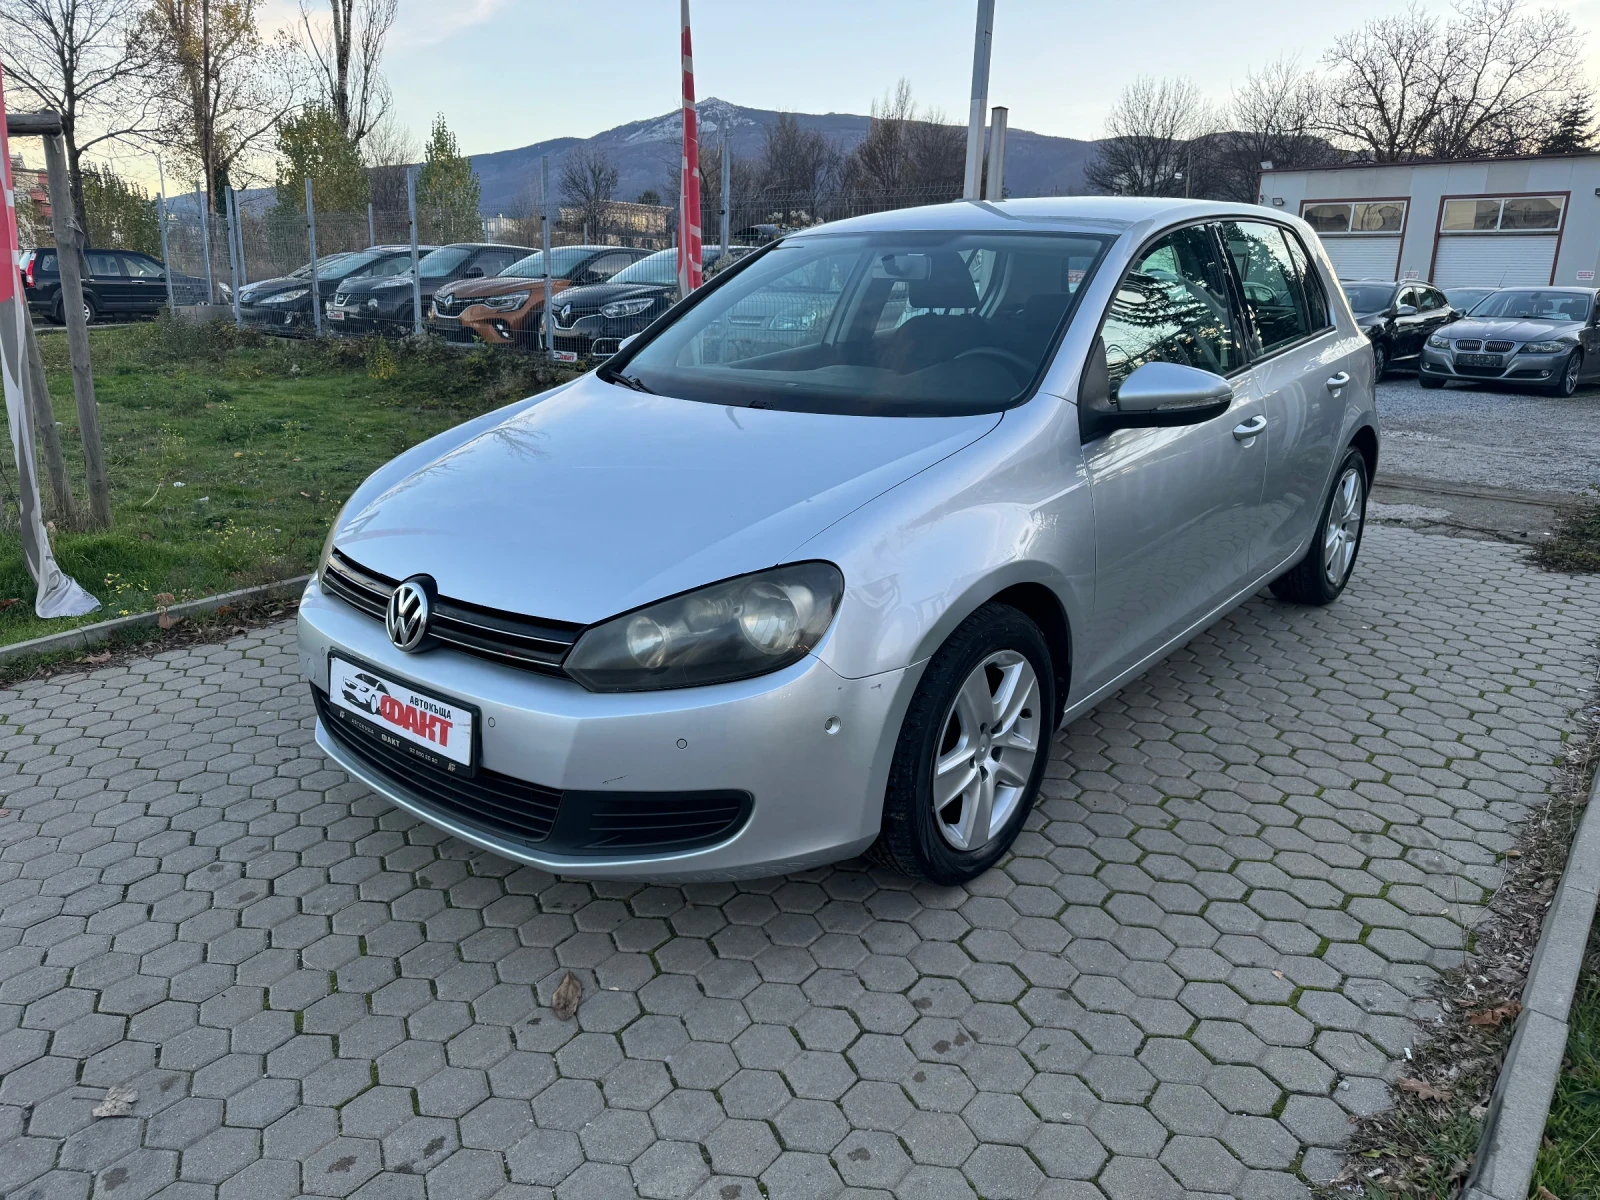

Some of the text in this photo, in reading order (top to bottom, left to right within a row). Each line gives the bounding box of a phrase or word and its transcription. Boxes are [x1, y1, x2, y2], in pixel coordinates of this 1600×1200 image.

[387, 583, 427, 651] VW
[380, 694, 453, 747] ФАКТ
[409, 695, 452, 720] АВТОКЪЩА
[381, 733, 400, 748] ФАКТ
